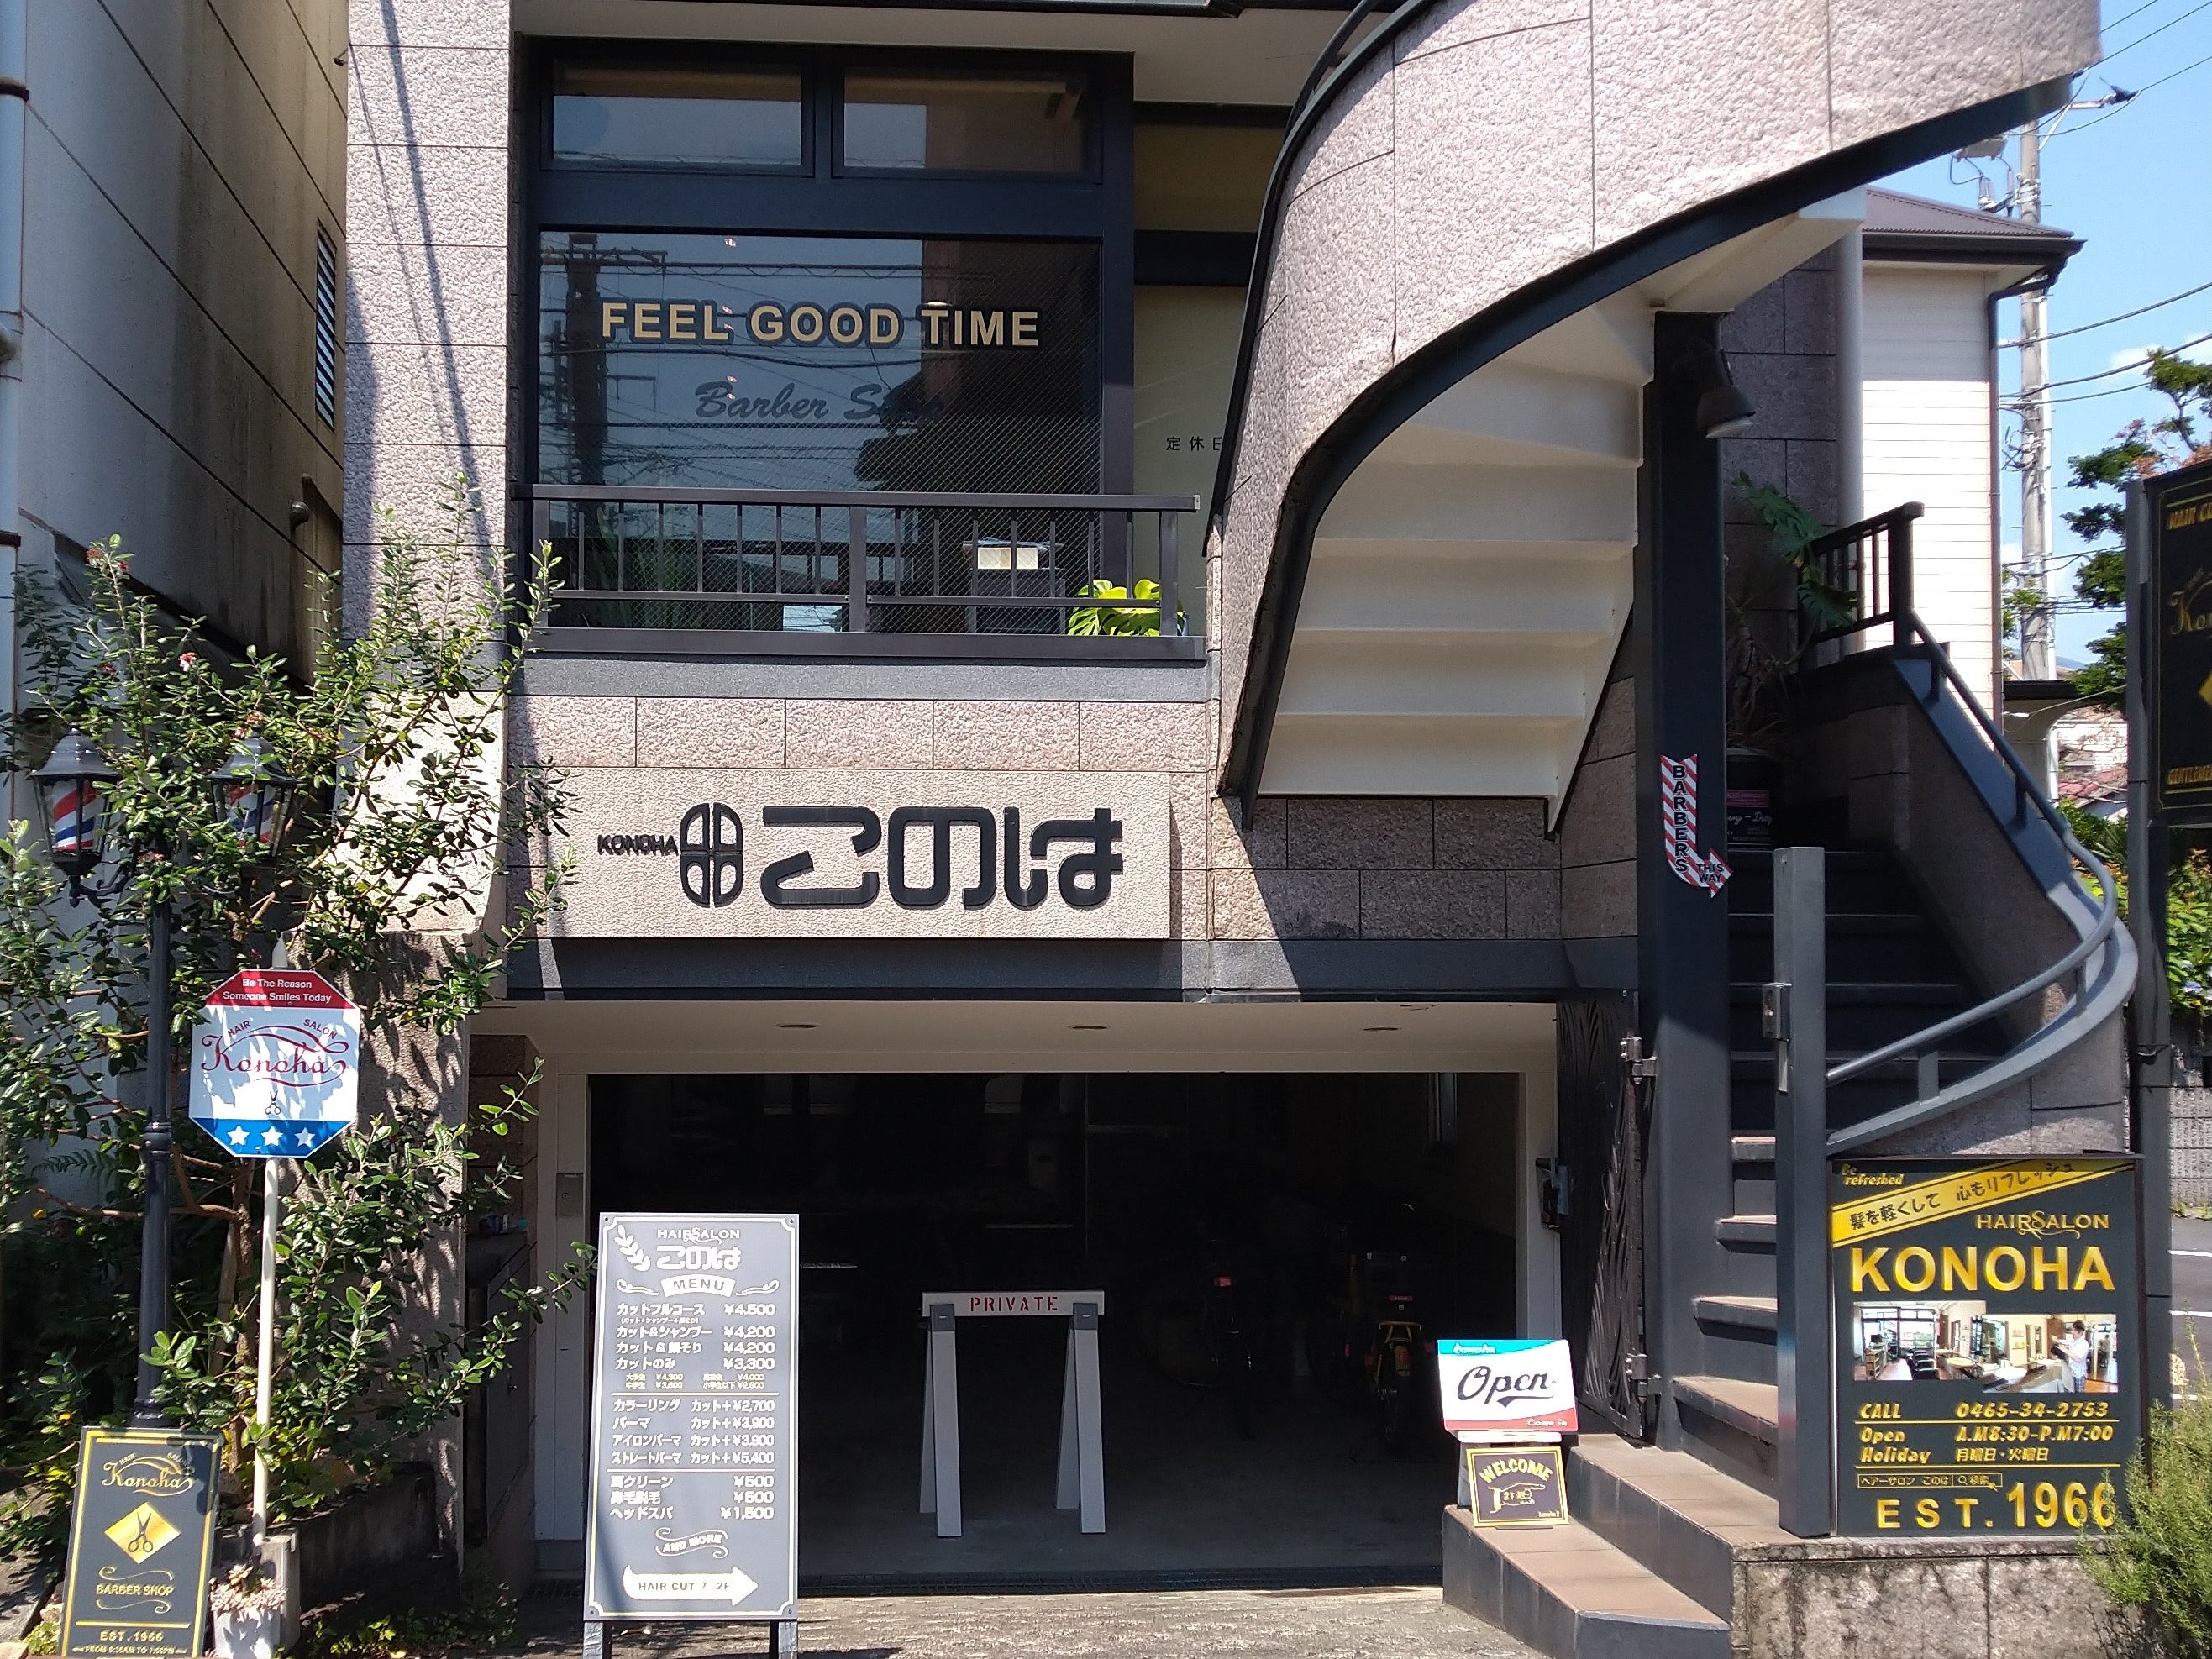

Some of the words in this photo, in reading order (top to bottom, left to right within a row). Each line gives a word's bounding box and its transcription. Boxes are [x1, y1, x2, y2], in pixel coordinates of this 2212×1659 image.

[601, 301, 730, 341] FEEL
[750, 305, 900, 344] GOOD
[920, 309, 1039, 347] TIME
[695, 381, 830, 420] Barber
[1673, 765, 1689, 872] BARBERS
[597, 834, 678, 857] KONOHA
[761, 805, 1123, 910] このは
[1696, 864, 1723, 873] THIS
[1699, 874, 1721, 883] WAY
[243, 979, 255, 988] Be
[257, 979, 276, 988] The
[277, 979, 312, 989] Reason
[223, 991, 267, 1000] Someone
[269, 993, 300, 1002] Smiles
[303, 994, 332, 1004] Today
[227, 1020, 252, 1037] HAIR
[303, 1018, 337, 1040] SALON
[201, 1032, 347, 1075] Konoha
[1842, 1163, 1857, 1176] Be
[1844, 1173, 1905, 1186] refreshed
[1850, 1192, 1941, 1231] 髪を軽くして
[1955, 1163, 2076, 1202] 心もリフレッシュ
[656, 1245, 741, 1271] このは
[1850, 1246, 2115, 1293] KONOHA
[673, 1278, 725, 1290] MENU
[617, 1302, 706, 1315] カットフルコース
[970, 1296, 1059, 1312] PRIVATE
[723, 1326, 775, 1339] ¥4,200
[723, 1341, 775, 1354] ¥4,200
[615, 1357, 676, 1370] カットのみ
[723, 1357, 775, 1371] ¥3,300
[1457, 1365, 1557, 1405] Open
[613, 1399, 681, 1412] カラーリング
[1859, 1403, 1902, 1420] CALL
[1955, 1402, 2109, 1419] 0465-34-2753
[612, 1416, 651, 1429] パーマ
[612, 1434, 682, 1446] アイロンパーマ
[1859, 1426, 1906, 1444] Open
[611, 1452, 682, 1465] ストレートパーマ
[1860, 1447, 1932, 1465] Holiday
[1956, 1447, 2050, 1462] 月曜日・火曜日
[102, 1461, 194, 1488] Konoha
[1479, 1458, 1553, 1483] WELCOME
[1861, 1476, 1916, 1486] ヘアーサロン
[1921, 1476, 1950, 1486] このは
[609, 1506, 674, 1520] ヘッドスパ
[720, 1506, 775, 1520] ¥1,500
[662, 1540, 687, 1553] AND
[688, 1533, 722, 1548] MORE
[96, 1583, 141, 1596] BARBER
[143, 1584, 175, 1597] SHOP
[638, 1582, 667, 1591] HAIR
[671, 1582, 696, 1591] CUT
[717, 1581, 731, 1591] 2F
